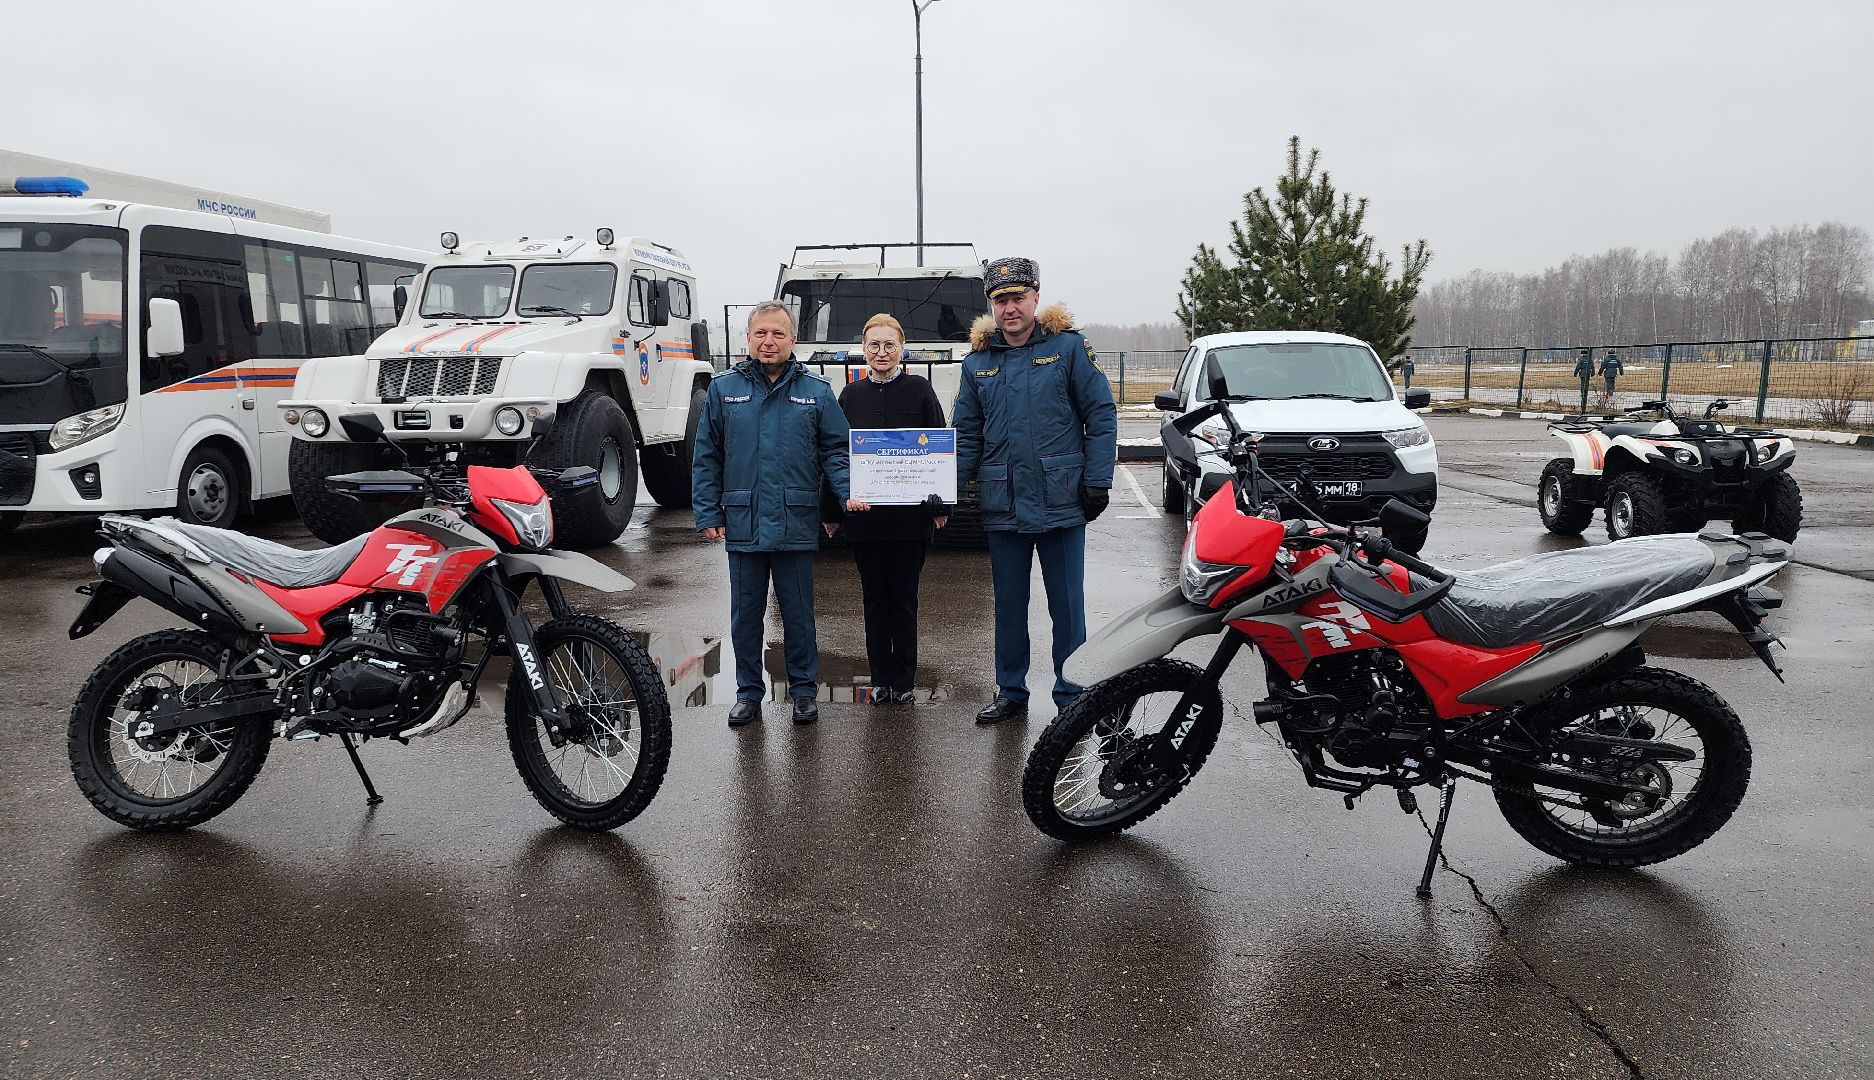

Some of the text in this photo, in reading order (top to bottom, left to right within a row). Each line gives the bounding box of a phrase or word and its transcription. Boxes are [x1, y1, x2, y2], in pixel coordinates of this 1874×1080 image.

[197, 199, 256, 219] МЧС РОССИИ
[1346, 482, 1358, 492] 18
[419, 513, 465, 532] ATAKI
[1262, 577, 1323, 609] ATAKI
[516, 642, 544, 690] ATAKI
[1170, 703, 1203, 750] ATAKI
